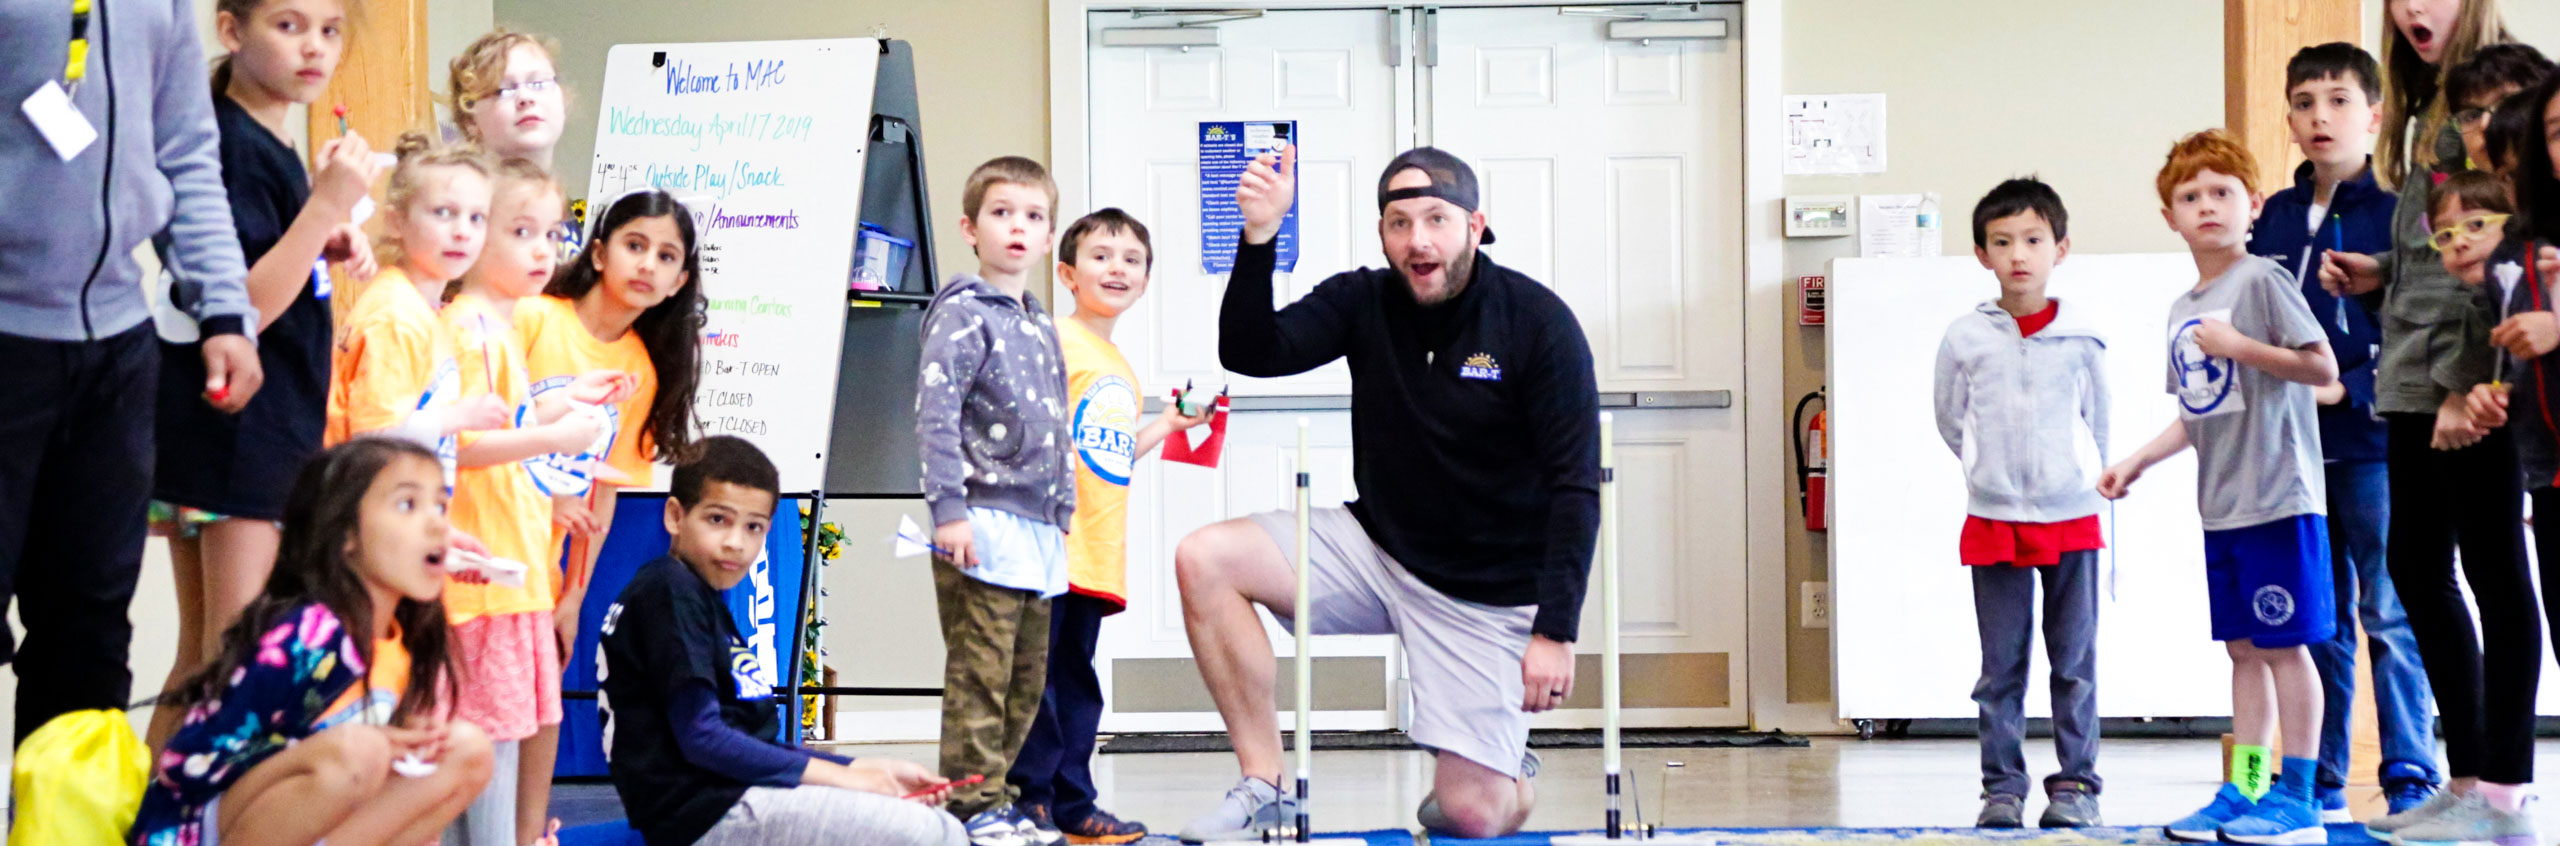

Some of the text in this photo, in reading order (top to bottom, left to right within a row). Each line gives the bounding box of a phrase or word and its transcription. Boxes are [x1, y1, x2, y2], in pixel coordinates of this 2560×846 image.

[667, 58, 786, 96] Welcome to MAC
[610, 106, 702, 152] Wednesday
[772, 114, 813, 142] 2019
[645, 161, 691, 188] Outside
[1803, 277, 1824, 288] FIR
[751, 362, 780, 376] OPEN
[716, 391, 753, 407] CLOSED
[725, 416, 767, 435] CLOSED
